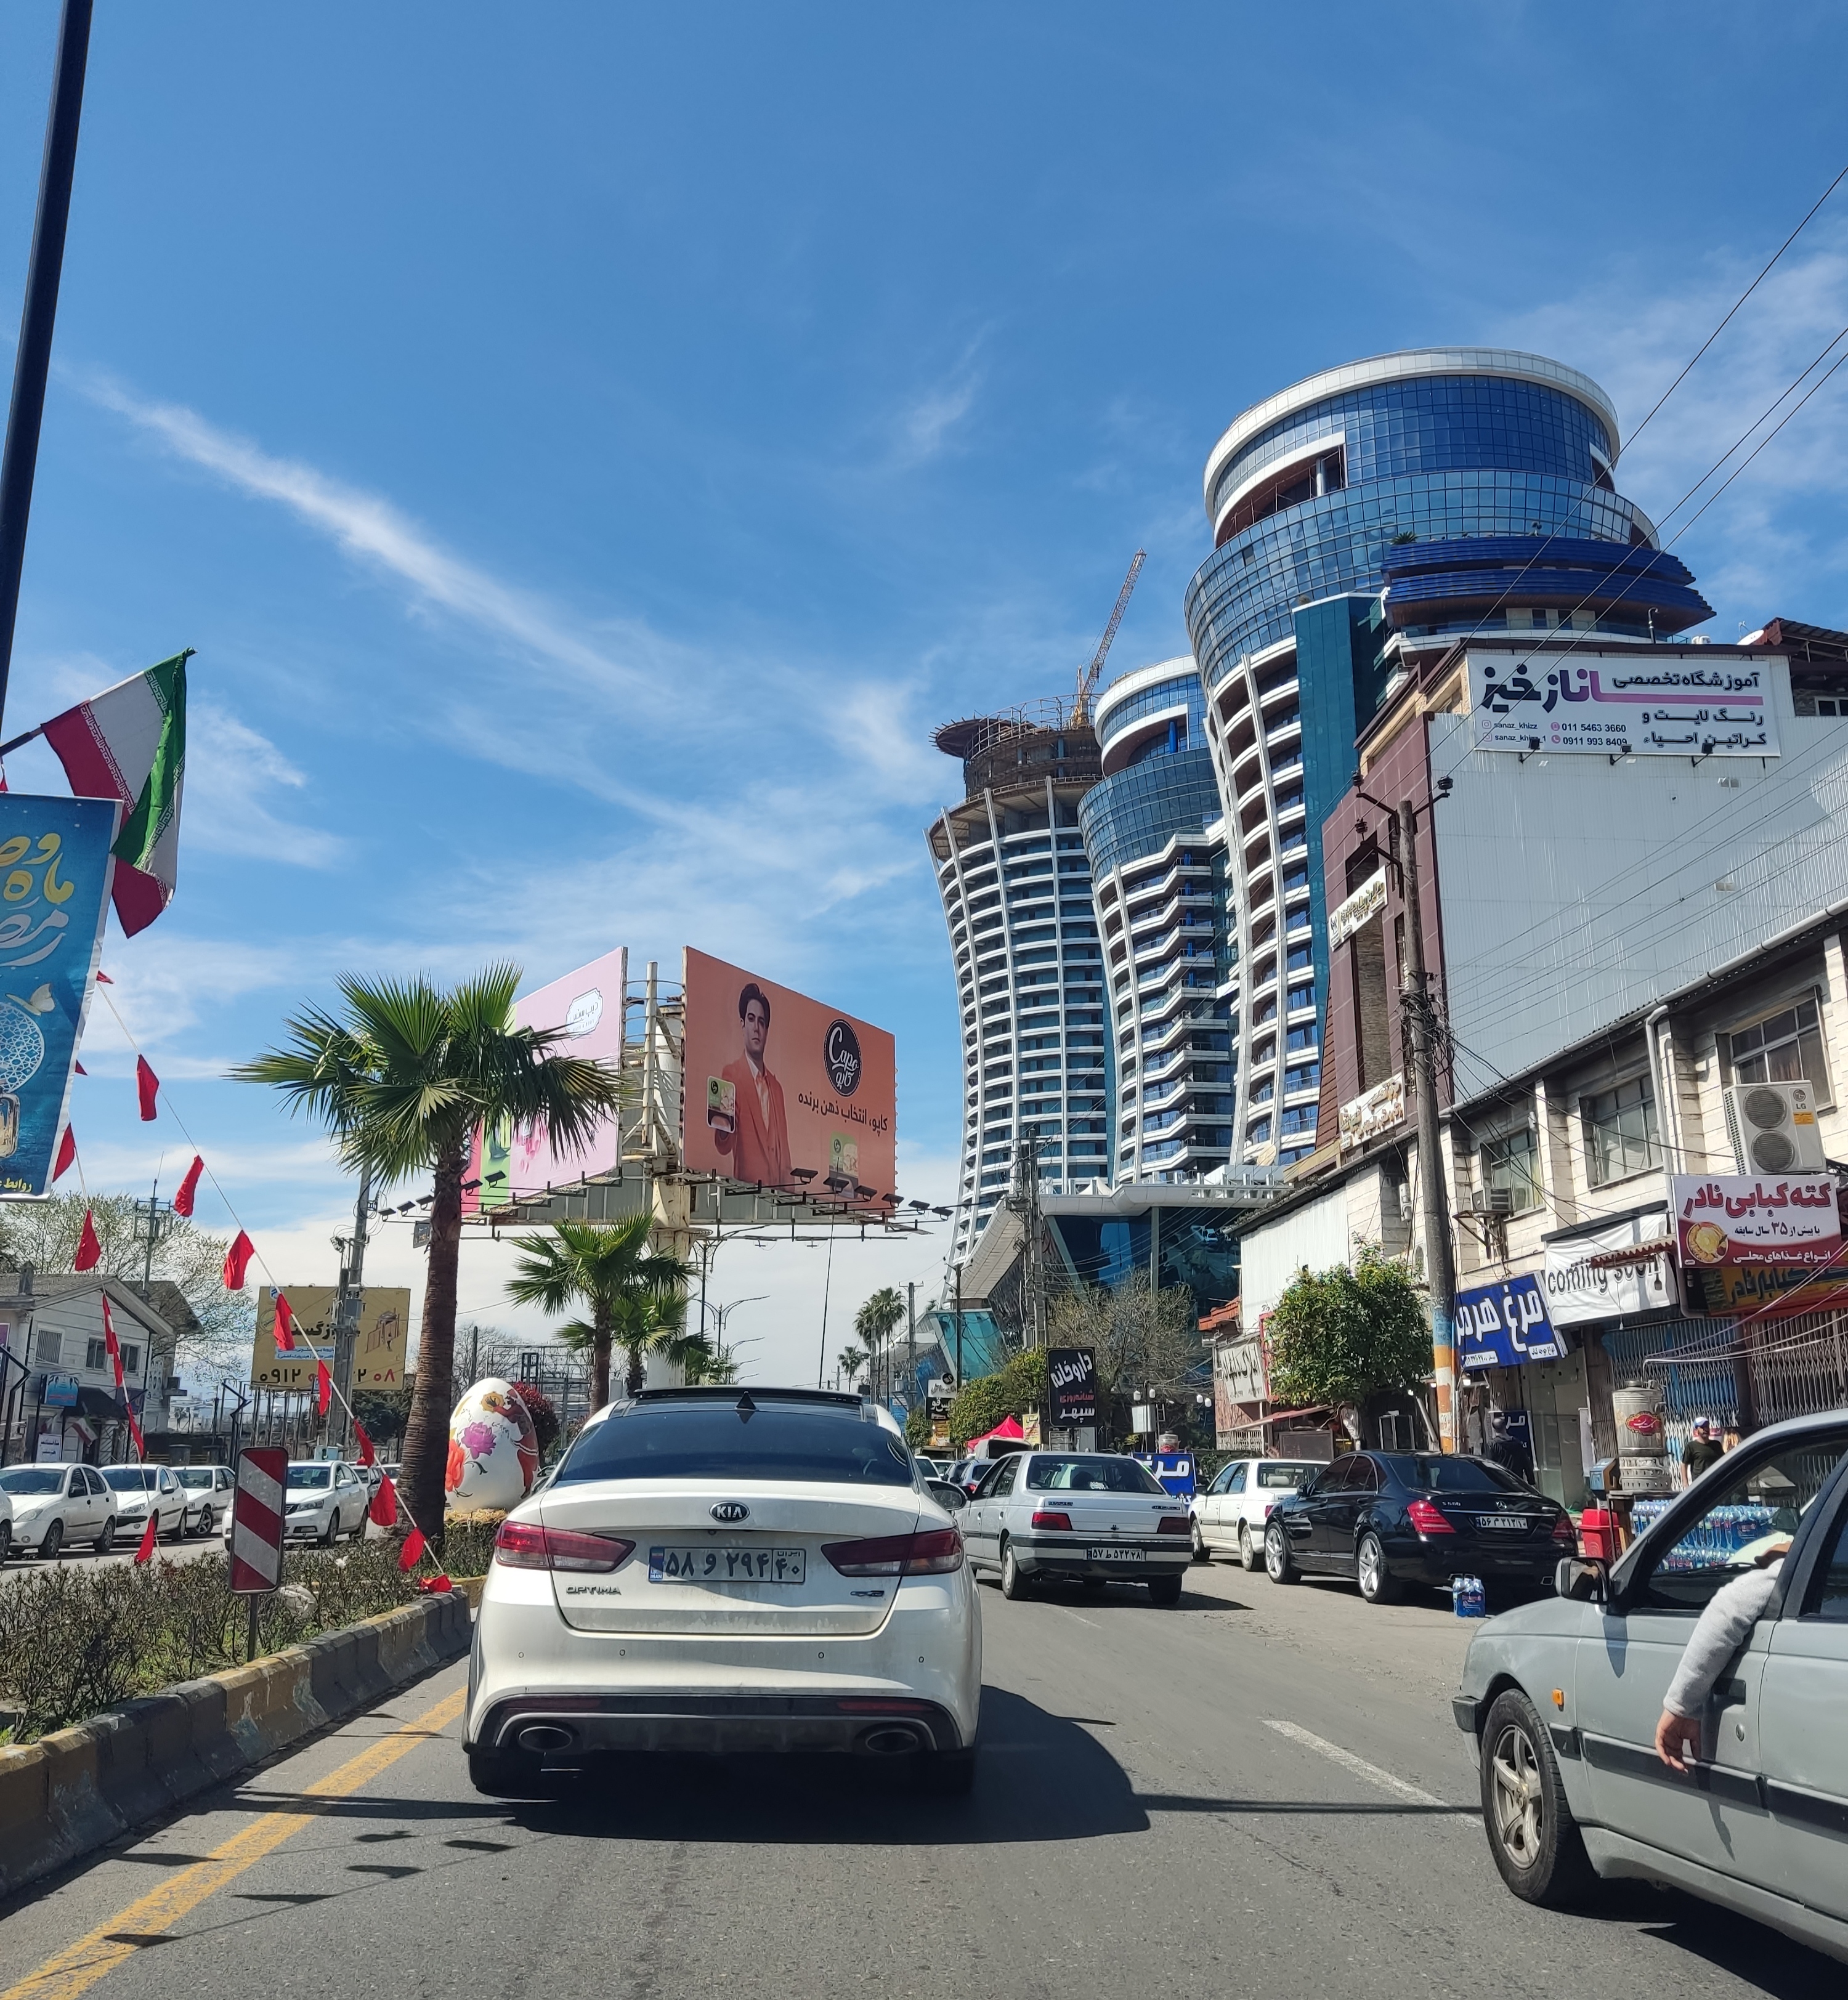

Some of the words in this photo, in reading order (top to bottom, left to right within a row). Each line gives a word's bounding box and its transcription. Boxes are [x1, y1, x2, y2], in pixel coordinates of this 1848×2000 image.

[1613, 671, 1680, 689] تخصصی
[1682, 670, 1760, 690] آموزشگاه
[1481, 663, 1541, 713] خیز
[1642, 711, 1650, 724] و
[1654, 710, 1709, 725] لایت
[1713, 708, 1763, 726] رنگ
[1494, 722, 1538, 731] sanaz_khizz
[1562, 724, 1578, 732] 011
[1581, 724, 1602, 732] 5463
[1605, 724, 1626, 732] 3660
[1563, 737, 1583, 745] 0911
[1587, 737, 1603, 745] 993
[1606, 738, 1627, 747] 8409
[829, 1026, 859, 1072] Capo
[798, 1091, 819, 1114] برنده
[821, 1100, 839, 1115] ذهن
[841, 1104, 867, 1125] انتخاب
[4, 1177, 32, 1192] روابط
[1683, 1183, 1724, 1218] نادر
[1725, 1182, 1789, 1218] کبابی
[1790, 1182, 1831, 1208] کته
[1735, 1226, 1754, 1237] سابقه
[1756, 1226, 1770, 1236] سال
[1771, 1221, 1788, 1236] ۳۵
[1789, 1226, 1796, 1237] از
[1733, 1250, 1764, 1263] محلی
[1765, 1251, 1803, 1263] غذاهای
[1804, 1250, 1831, 1263] انواع
[1503, 1285, 1543, 1352] مرغ
[1050, 1352, 1093, 1388] داروخانه
[1060, 1407, 1095, 1423] سپهر
[716, 1506, 743, 1518] KIA
[1481, 1518, 1491, 1526] ۵۶
[1494, 1518, 1499, 1526] م
[1093, 1549, 1103, 1558] ۵۷
[1105, 1550, 1112, 1559] ط
[666, 1552, 695, 1577] ۵۸
[703, 1553, 716, 1575] و
[726, 1552, 769, 1578] ۲۹۴
[776, 1557, 800, 1579] ۴۰
[566, 1586, 622, 1595] OPTIMA
